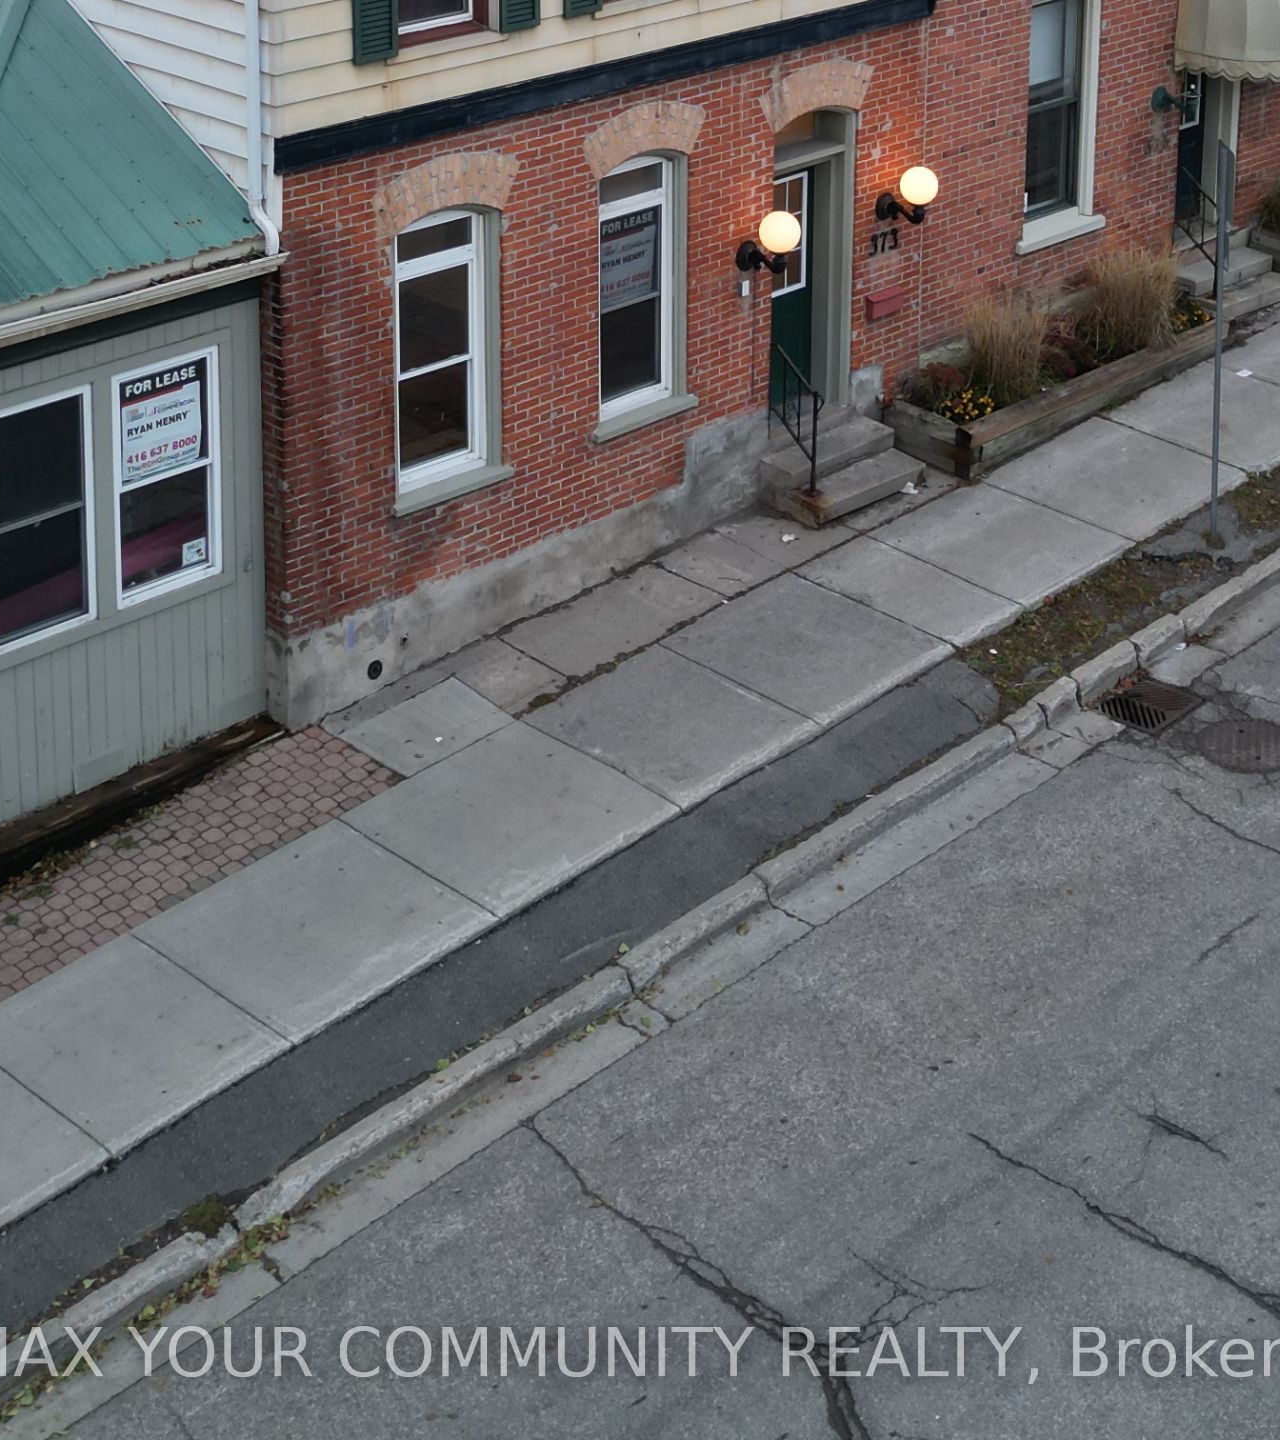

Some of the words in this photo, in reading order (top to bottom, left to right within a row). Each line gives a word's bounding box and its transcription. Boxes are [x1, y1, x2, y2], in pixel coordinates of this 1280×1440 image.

[602, 222, 621, 236] FOR
[623, 211, 655, 229] LEASE
[125, 379, 152, 398] FOR
[155, 365, 197, 389] LEASE
[127, 422, 153, 438] RYAN
[155, 411, 189, 429] HENRY
[126, 451, 148, 464] 416
[150, 443, 169, 458] 637
[172, 435, 198, 450] 8000
